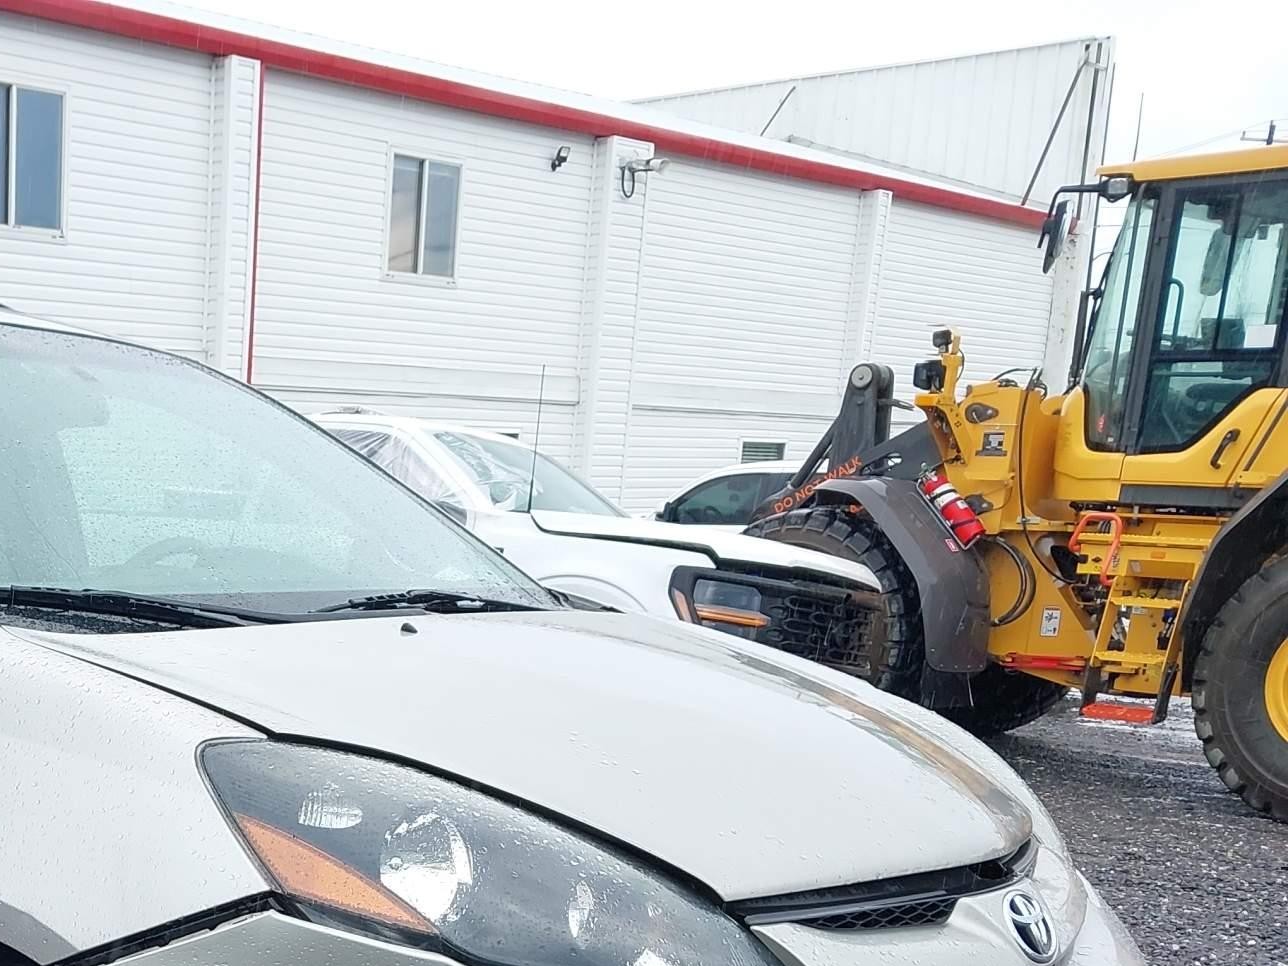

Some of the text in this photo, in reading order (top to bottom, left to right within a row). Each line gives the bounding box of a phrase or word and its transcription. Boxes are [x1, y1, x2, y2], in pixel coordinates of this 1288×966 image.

[774, 456, 862, 513] DO NOT WALK
